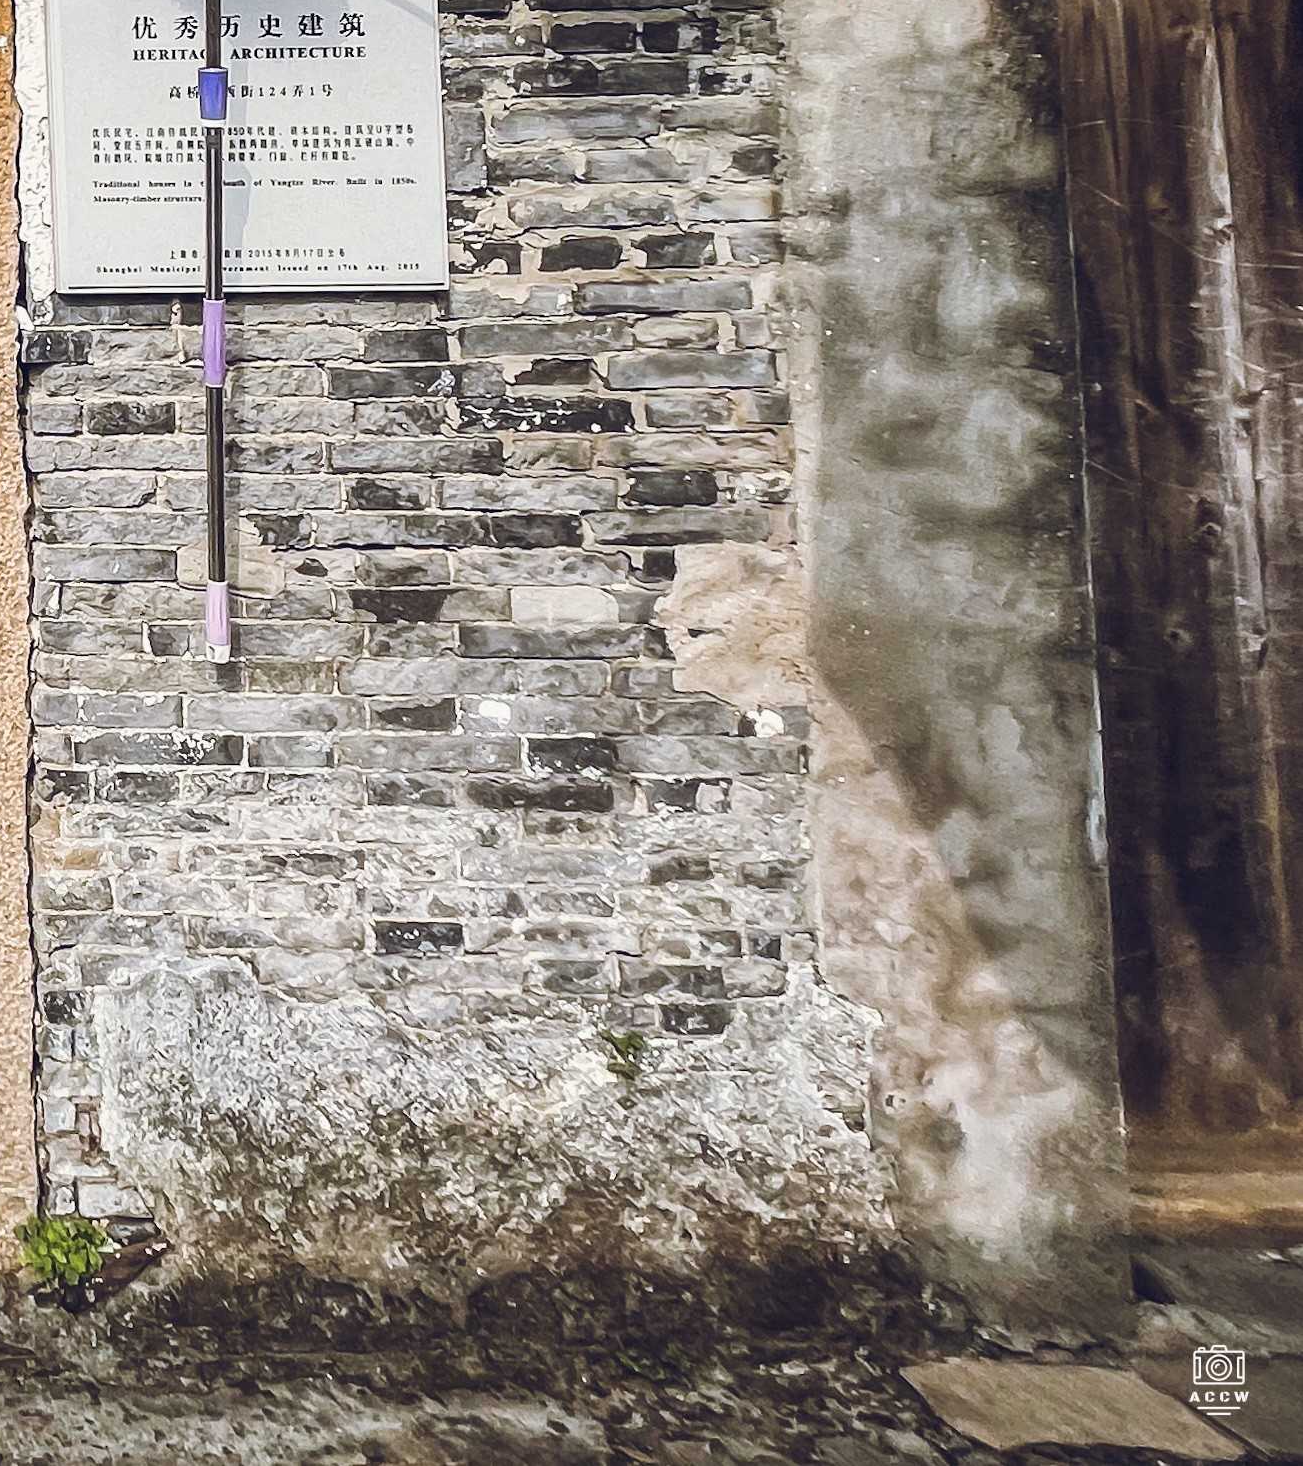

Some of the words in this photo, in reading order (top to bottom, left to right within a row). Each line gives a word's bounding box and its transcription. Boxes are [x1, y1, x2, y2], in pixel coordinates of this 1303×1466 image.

[132, 13, 366, 40] 优秀历史建筑
[133, 48, 205, 61] HERITA
[230, 46, 367, 60] ARCHITECTURE
[93, 180, 140, 188] Traditional
[253, 179, 262, 187] of
